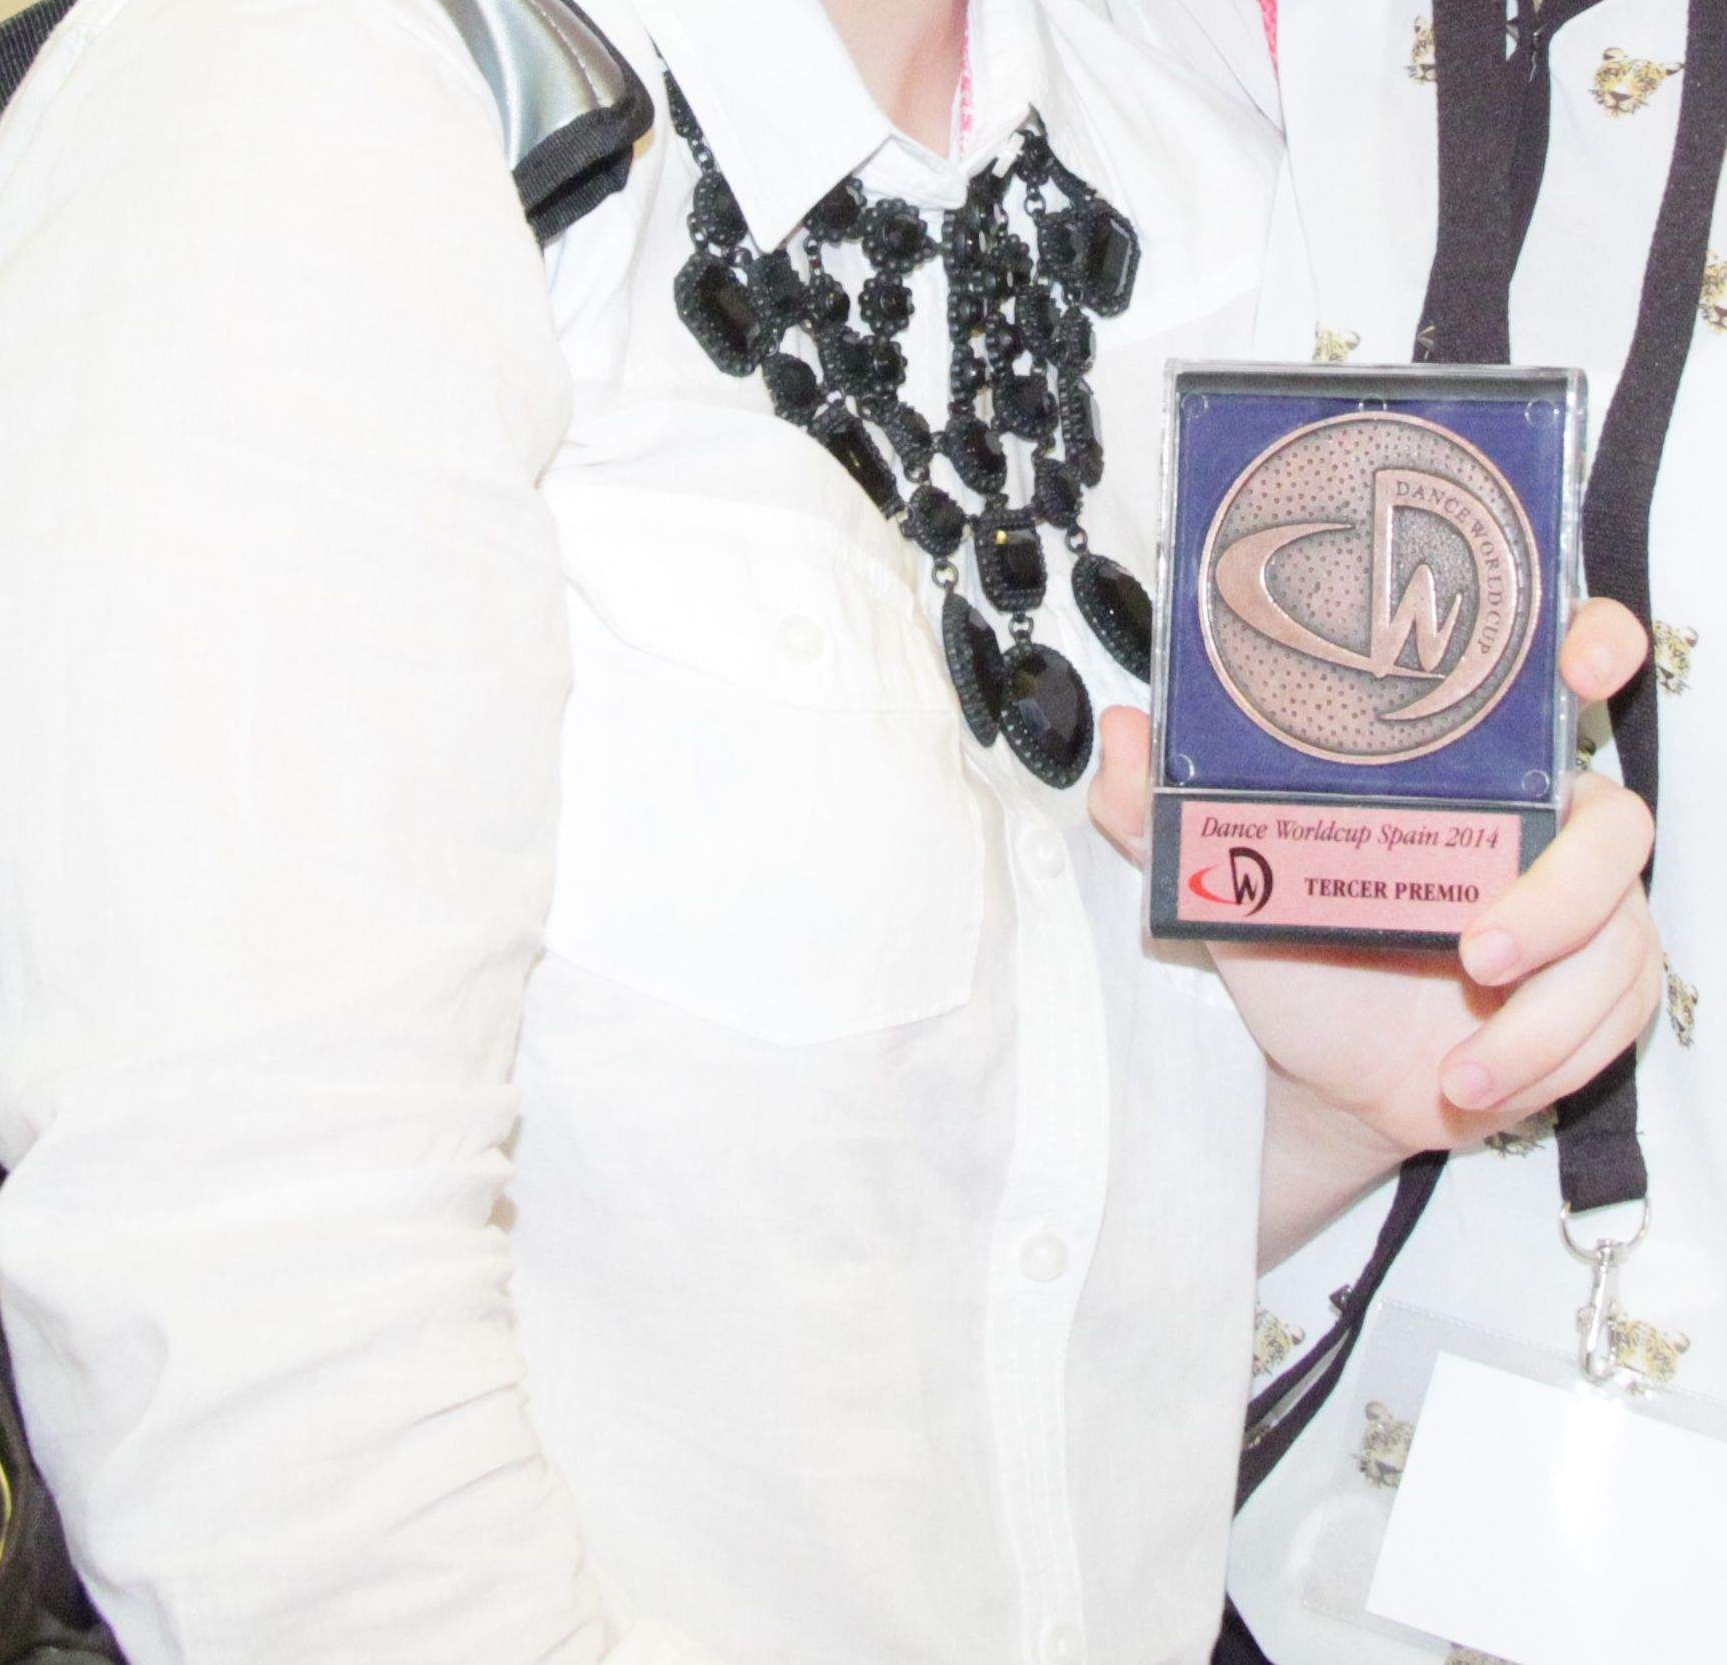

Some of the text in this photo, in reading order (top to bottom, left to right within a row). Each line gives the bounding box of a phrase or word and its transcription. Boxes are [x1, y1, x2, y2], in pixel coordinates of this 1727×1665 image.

[1395, 480, 1503, 655] DANCE WORLDCUP
[1201, 816, 1500, 850] Dance Worldcup Spain 2014
[1304, 877, 1480, 904] TERCER PREMIO
